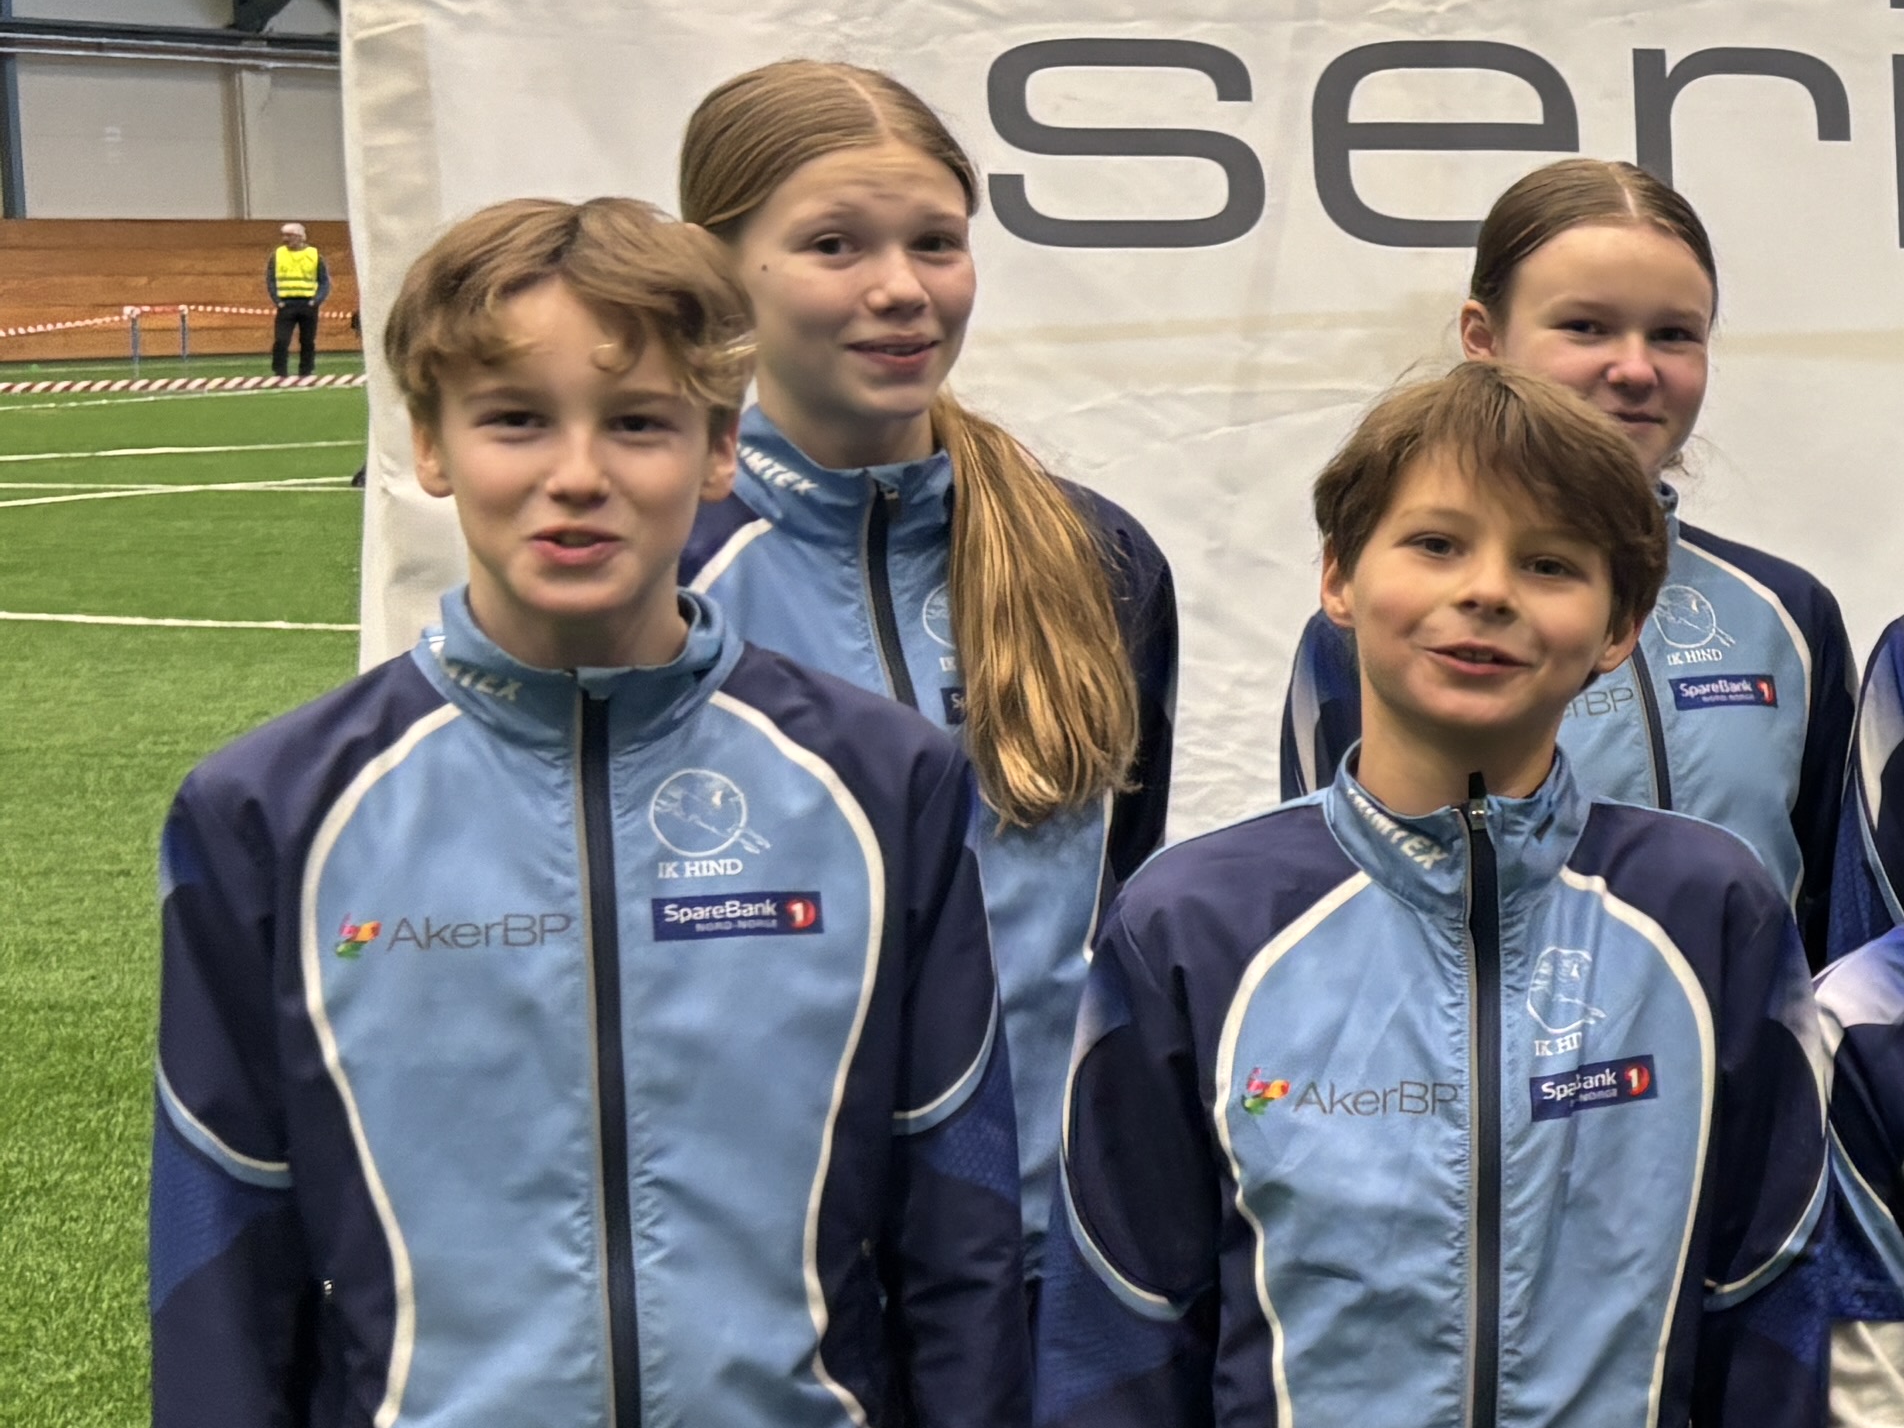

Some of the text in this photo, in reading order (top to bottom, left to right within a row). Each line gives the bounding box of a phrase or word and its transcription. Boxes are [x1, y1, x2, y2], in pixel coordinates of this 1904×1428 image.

[1686, 649, 1722, 664] HIND
[1680, 679, 1752, 697] SpareBank
[657, 858, 743, 878] IK HIND
[664, 899, 777, 923] SpareBank
[386, 913, 572, 952] AkerBP
[1292, 1081, 1458, 1118] AkerBP
